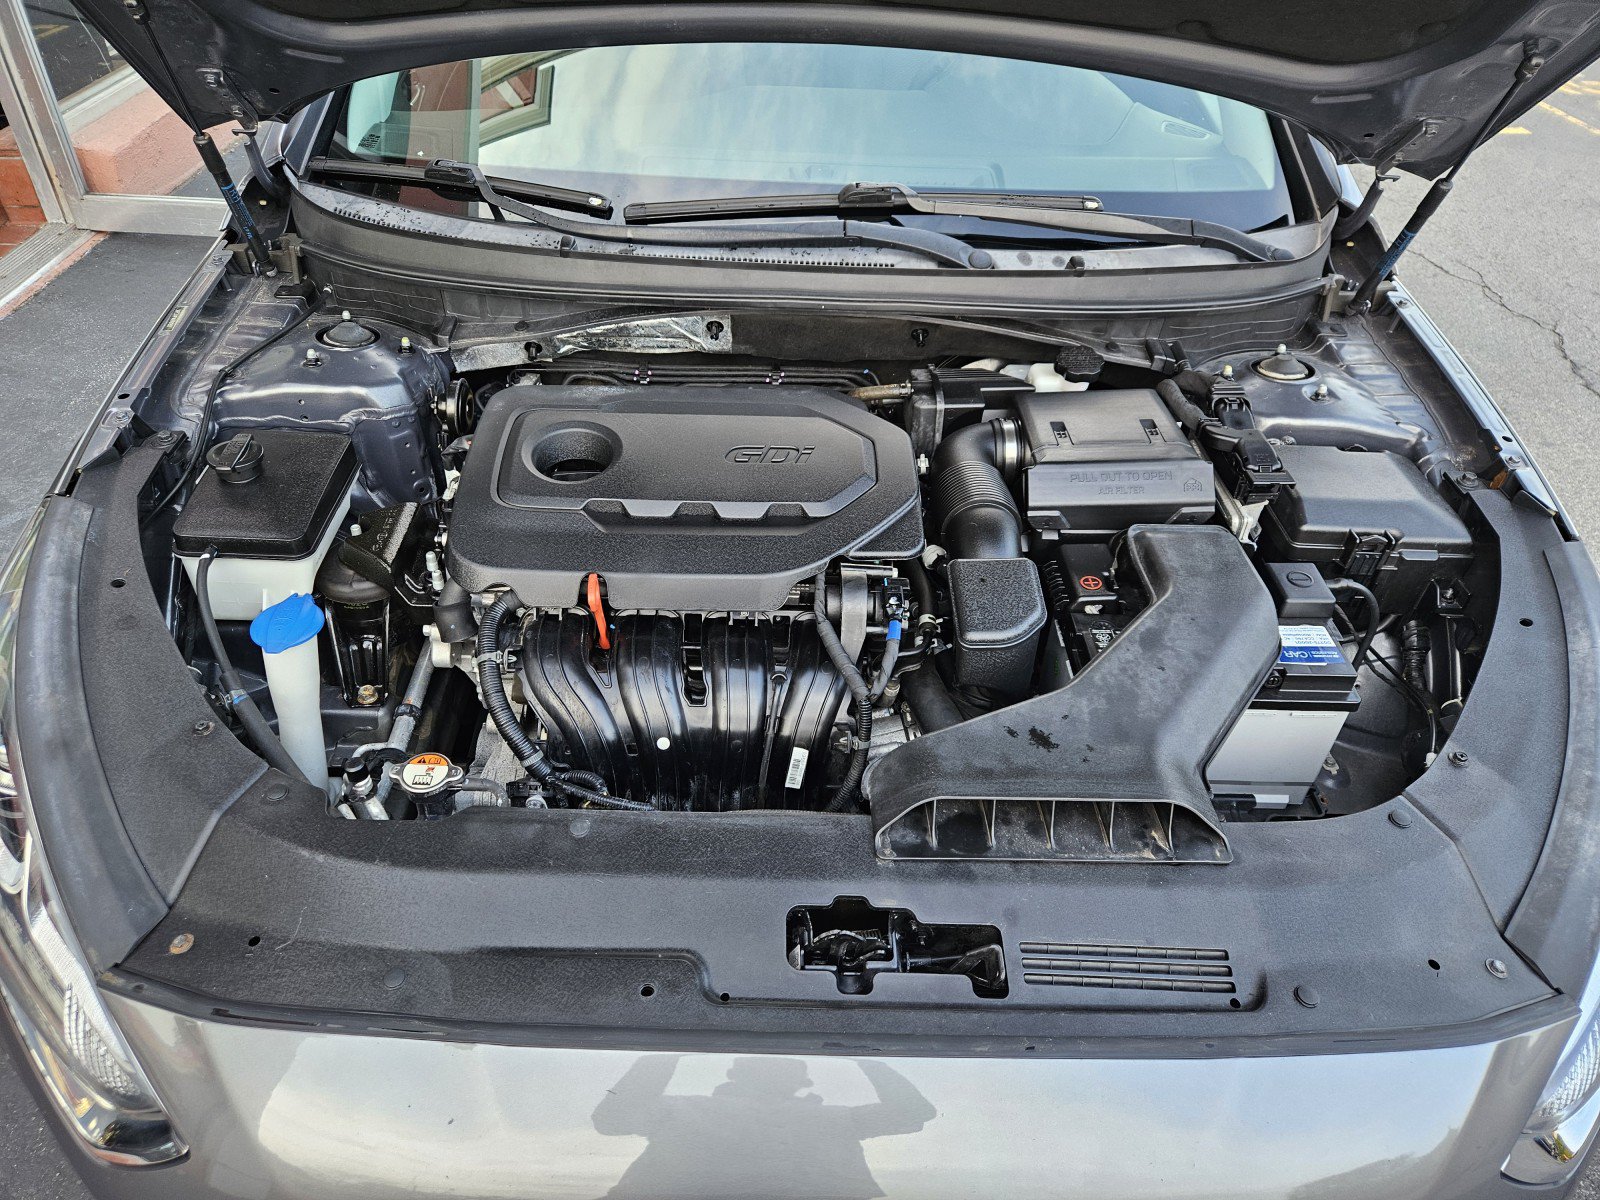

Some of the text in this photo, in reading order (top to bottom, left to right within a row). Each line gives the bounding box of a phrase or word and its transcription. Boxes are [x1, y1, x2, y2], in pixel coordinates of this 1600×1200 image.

[724, 445, 816, 464] GDi
[1069, 470, 1173, 482] PULL OUT TO OPEN
[1098, 486, 1145, 494] AIR FILTER
[1284, 650, 1308, 658] CAR
